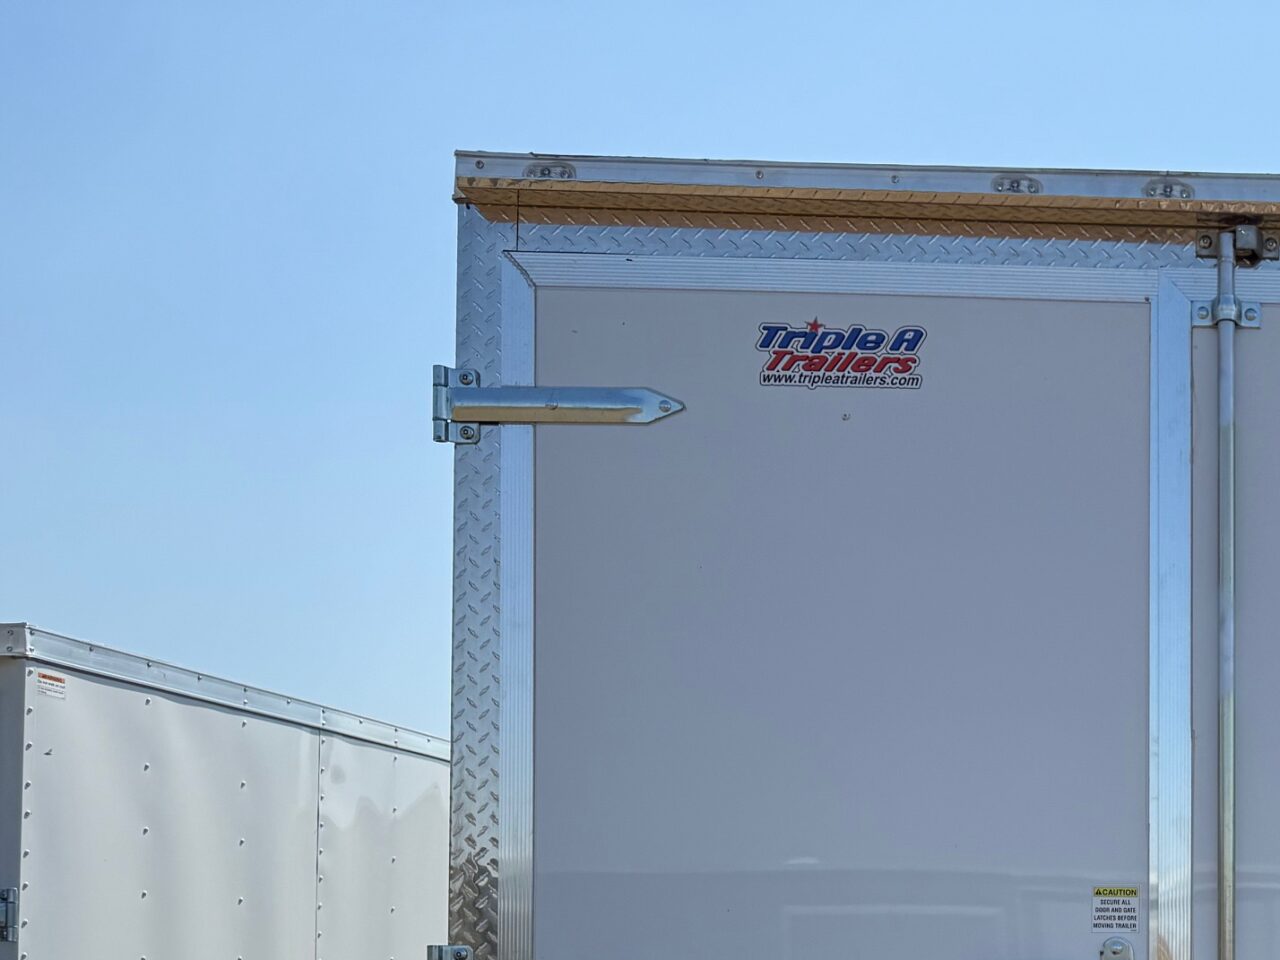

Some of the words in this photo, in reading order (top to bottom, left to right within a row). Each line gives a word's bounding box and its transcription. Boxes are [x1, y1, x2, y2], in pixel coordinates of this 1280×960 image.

[758, 323, 886, 354] Triple
[889, 328, 924, 352] A
[766, 350, 917, 374] Trailers
[762, 373, 919, 386] www.tripleatrailers.com
